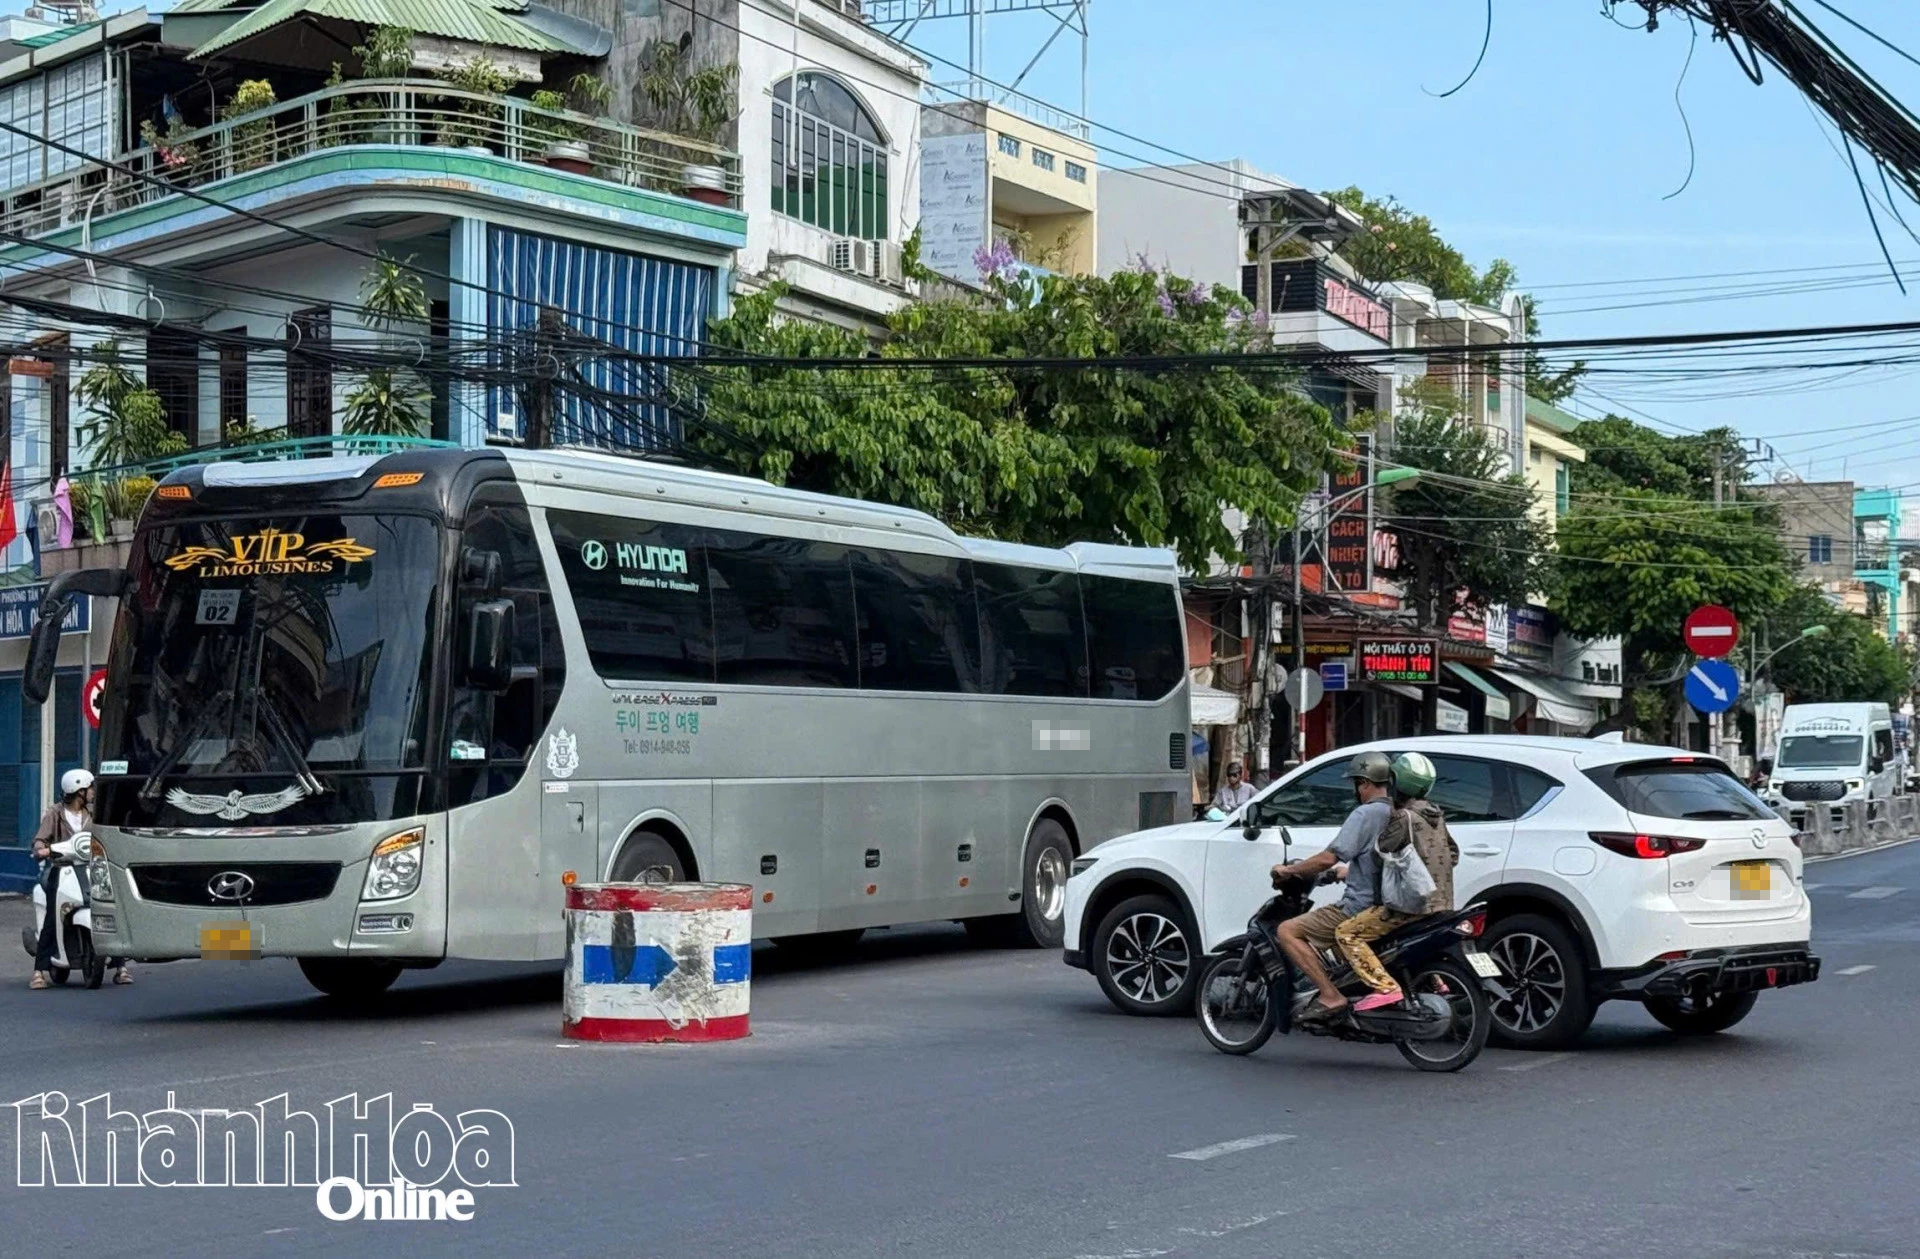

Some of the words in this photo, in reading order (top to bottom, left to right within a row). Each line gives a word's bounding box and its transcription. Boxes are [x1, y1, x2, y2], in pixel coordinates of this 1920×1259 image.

[1331, 519, 1365, 537] CÁCH
[229, 529, 306, 563] VIP
[1329, 543, 1366, 566] NHIỆT
[615, 541, 688, 574] HYUNDAI
[199, 560, 333, 578] LIMOUSINES
[620, 574, 656, 588] Innovation
[656, 578, 668, 589] For
[669, 580, 699, 593] Humanity
[1345, 569, 1362, 588] TÔ
[27, 586, 39, 602] TÂN
[6, 603, 24, 634] HÓA
[205, 606, 230, 621] 02
[1363, 642, 1381, 655] NỘI
[1381, 641, 1407, 655] THẤT
[1408, 642, 1417, 654] Ô
[1417, 642, 1432, 654] TÔ
[1363, 654, 1407, 671] THÀNH
[1409, 654, 1432, 671] TÍN
[615, 710, 641, 733] 두이
[646, 710, 670, 734] 프엉
[675, 710, 699, 735] 여행
[622, 738, 639, 754] Tel:
